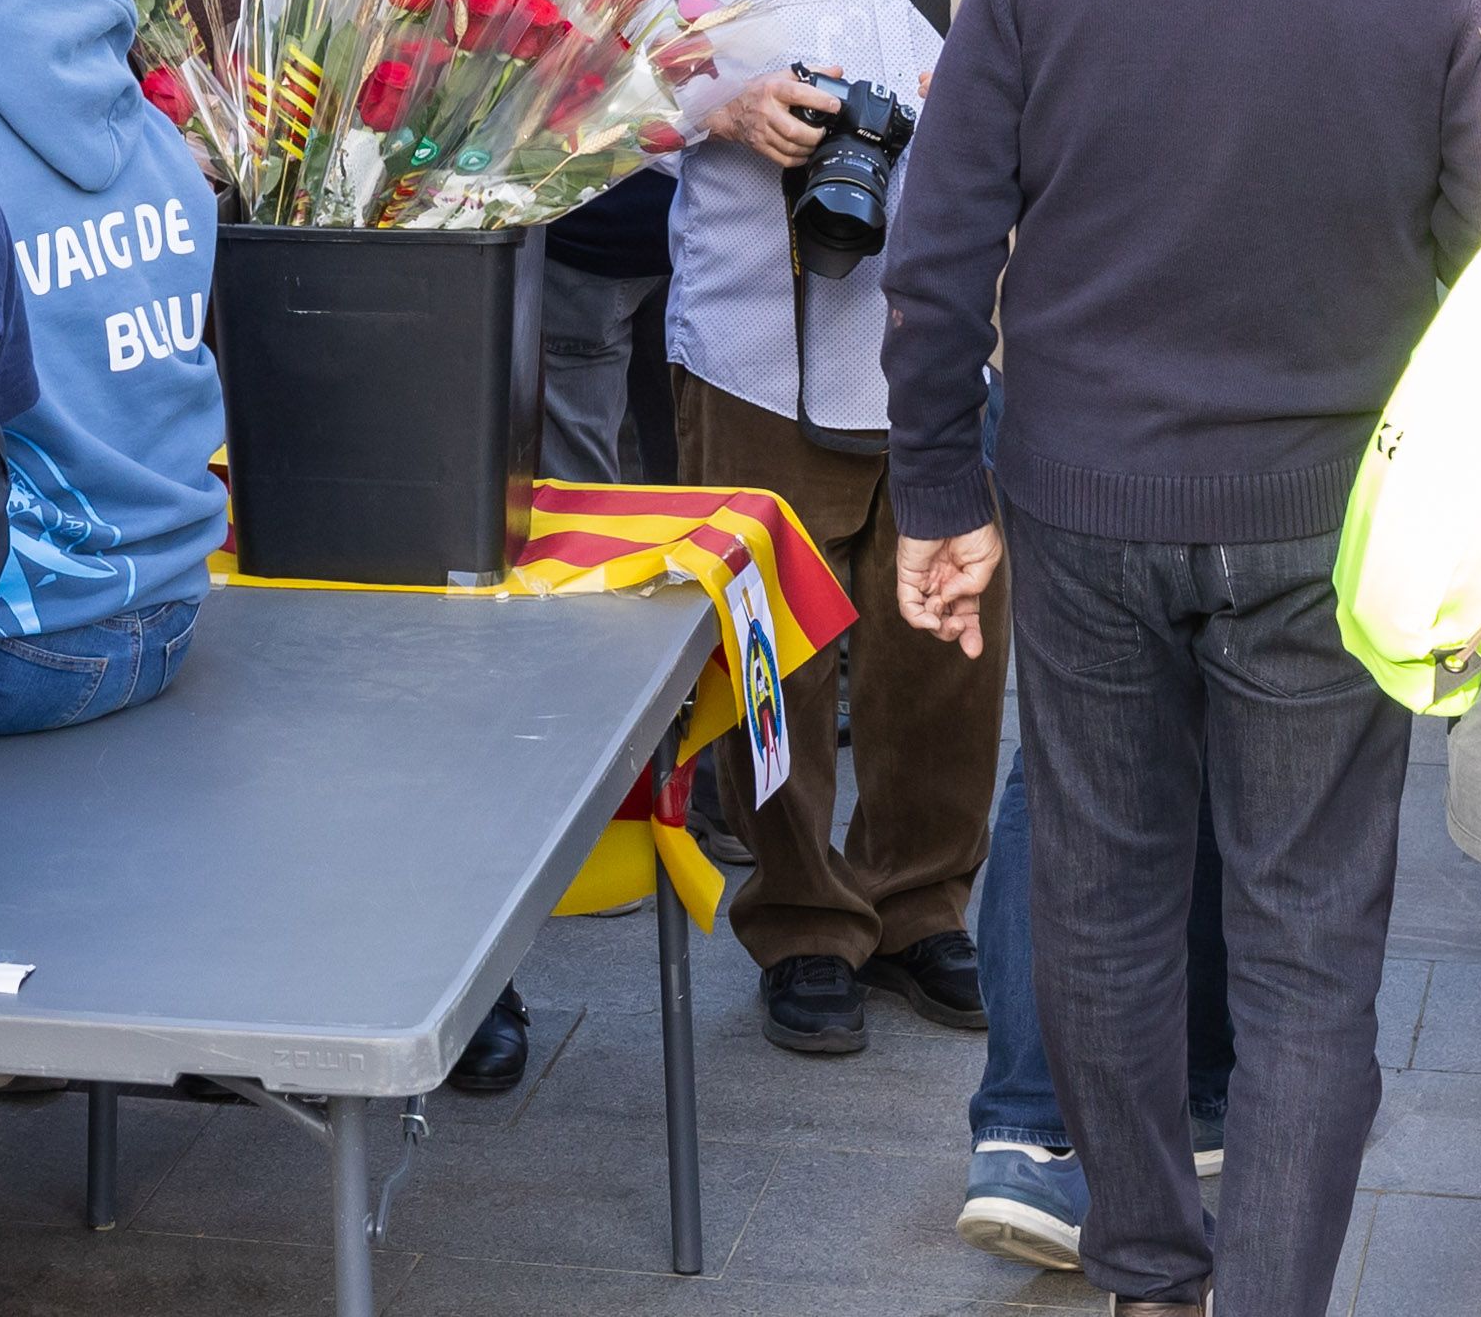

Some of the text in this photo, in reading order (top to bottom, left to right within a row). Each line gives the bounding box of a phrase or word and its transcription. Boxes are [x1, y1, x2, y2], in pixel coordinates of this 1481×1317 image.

[857, 128, 882, 143] Nikon
[14, 198, 196, 296] VAIG DE
